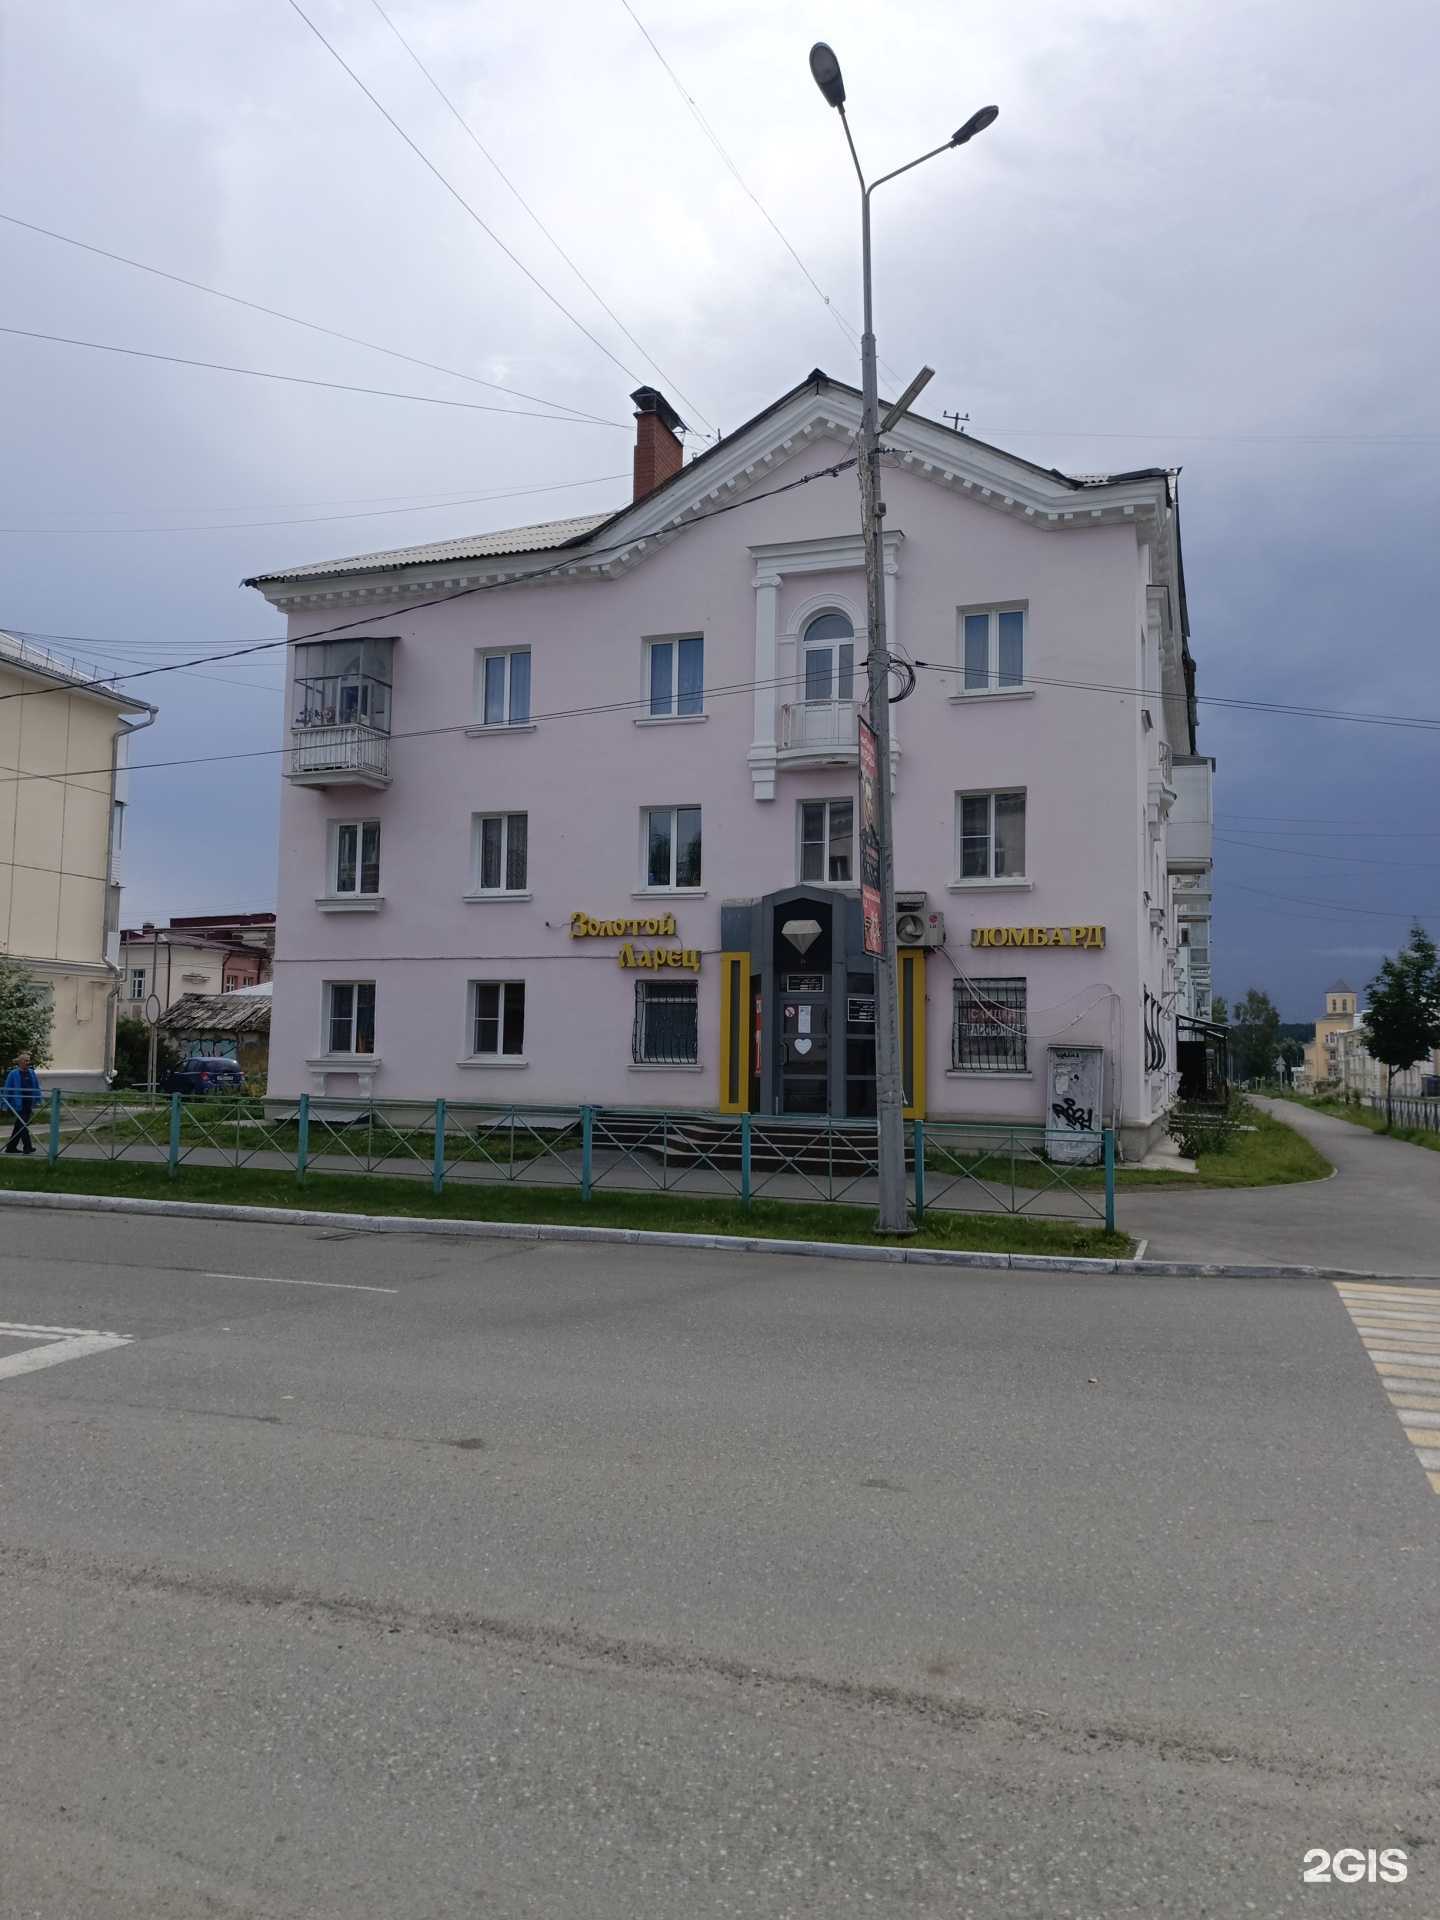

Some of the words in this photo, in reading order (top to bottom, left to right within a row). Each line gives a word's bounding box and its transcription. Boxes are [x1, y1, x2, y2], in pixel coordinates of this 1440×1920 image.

[571, 912, 676, 938] Золотой
[973, 927, 1104, 949] ЛОМБАРД
[618, 943, 702, 972] Ларец
